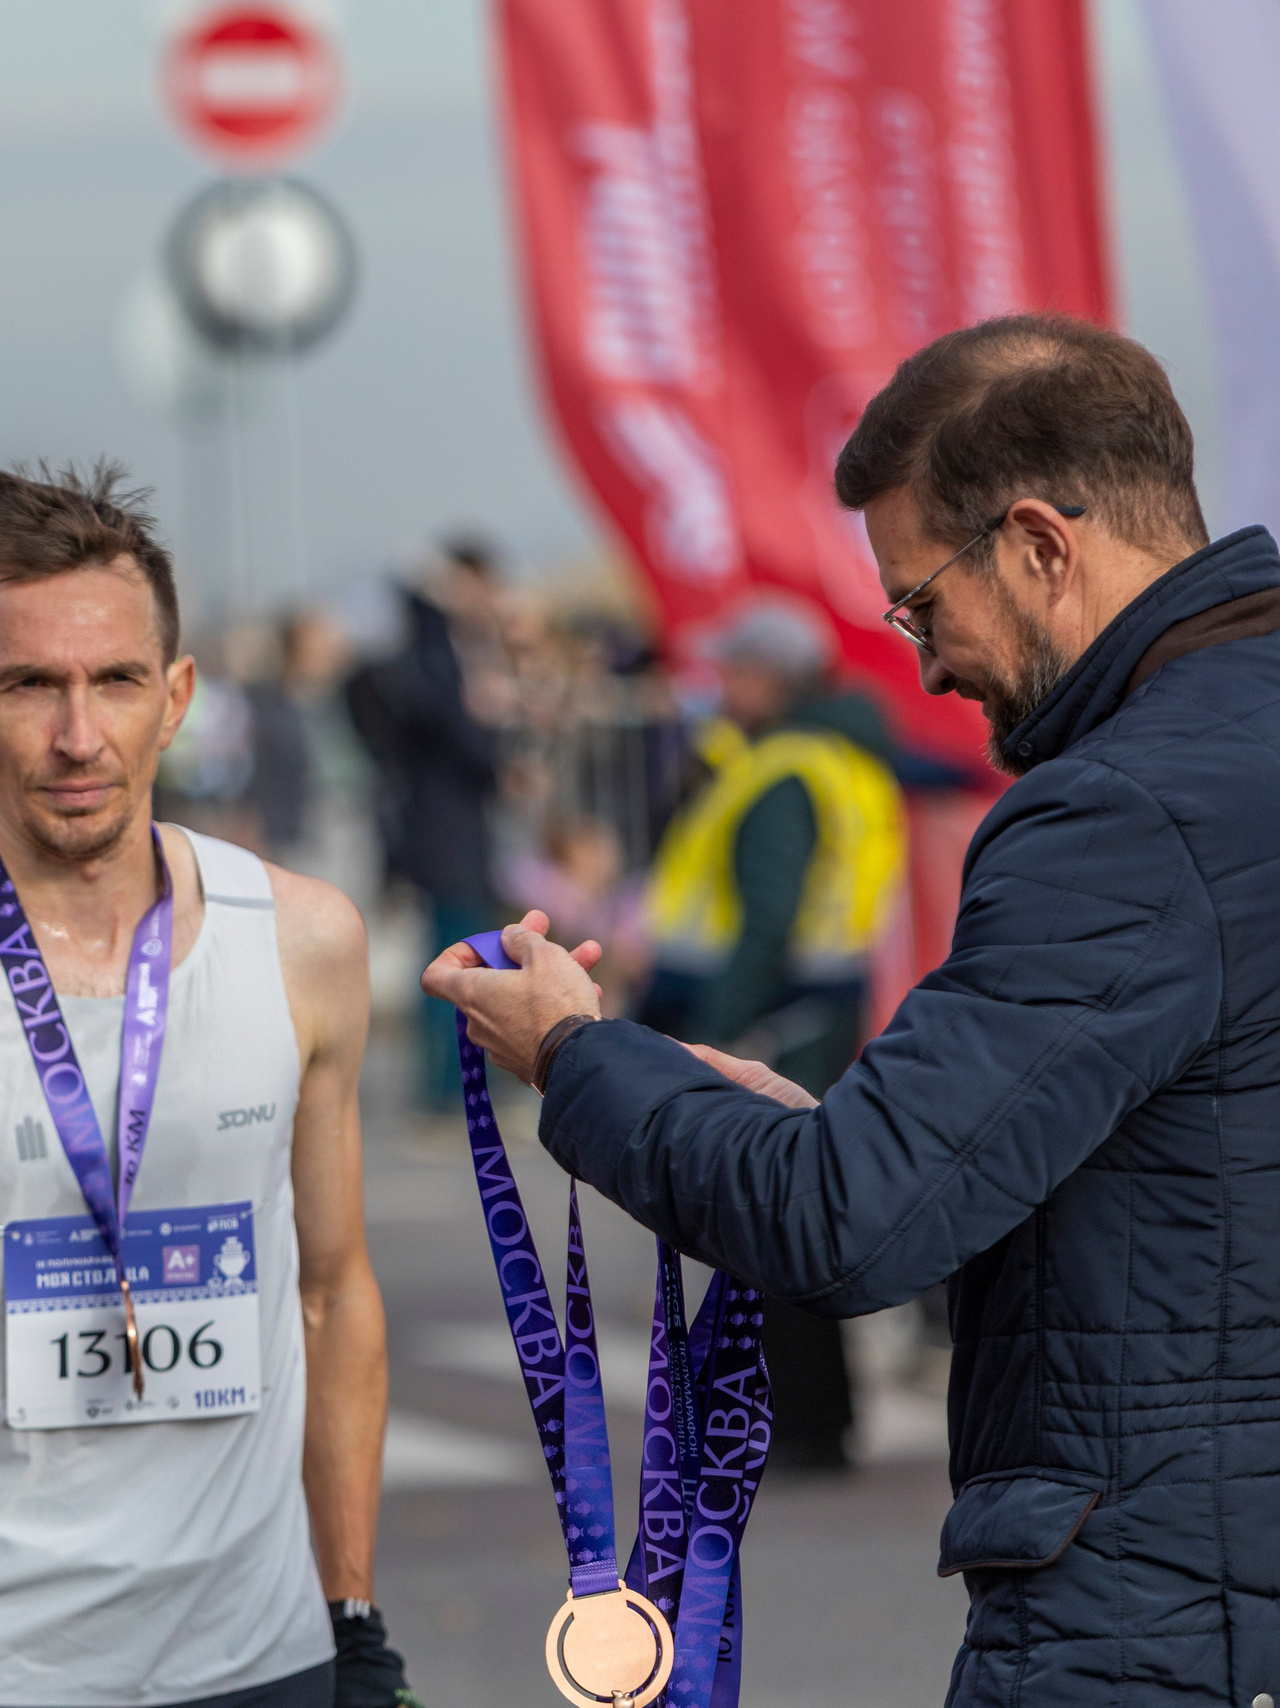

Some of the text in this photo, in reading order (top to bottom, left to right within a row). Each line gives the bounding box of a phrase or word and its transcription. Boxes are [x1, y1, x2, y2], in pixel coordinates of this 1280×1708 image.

[71, 1266, 150, 1288] СТОЛЦА
[473, 1145, 566, 1409] МОСКВА
[680, 1341, 699, 1457] ПОЛУМАРАФОН
[642, 1319, 686, 1584] МОСКВА
[679, 1365, 757, 1627] МОСКВА
